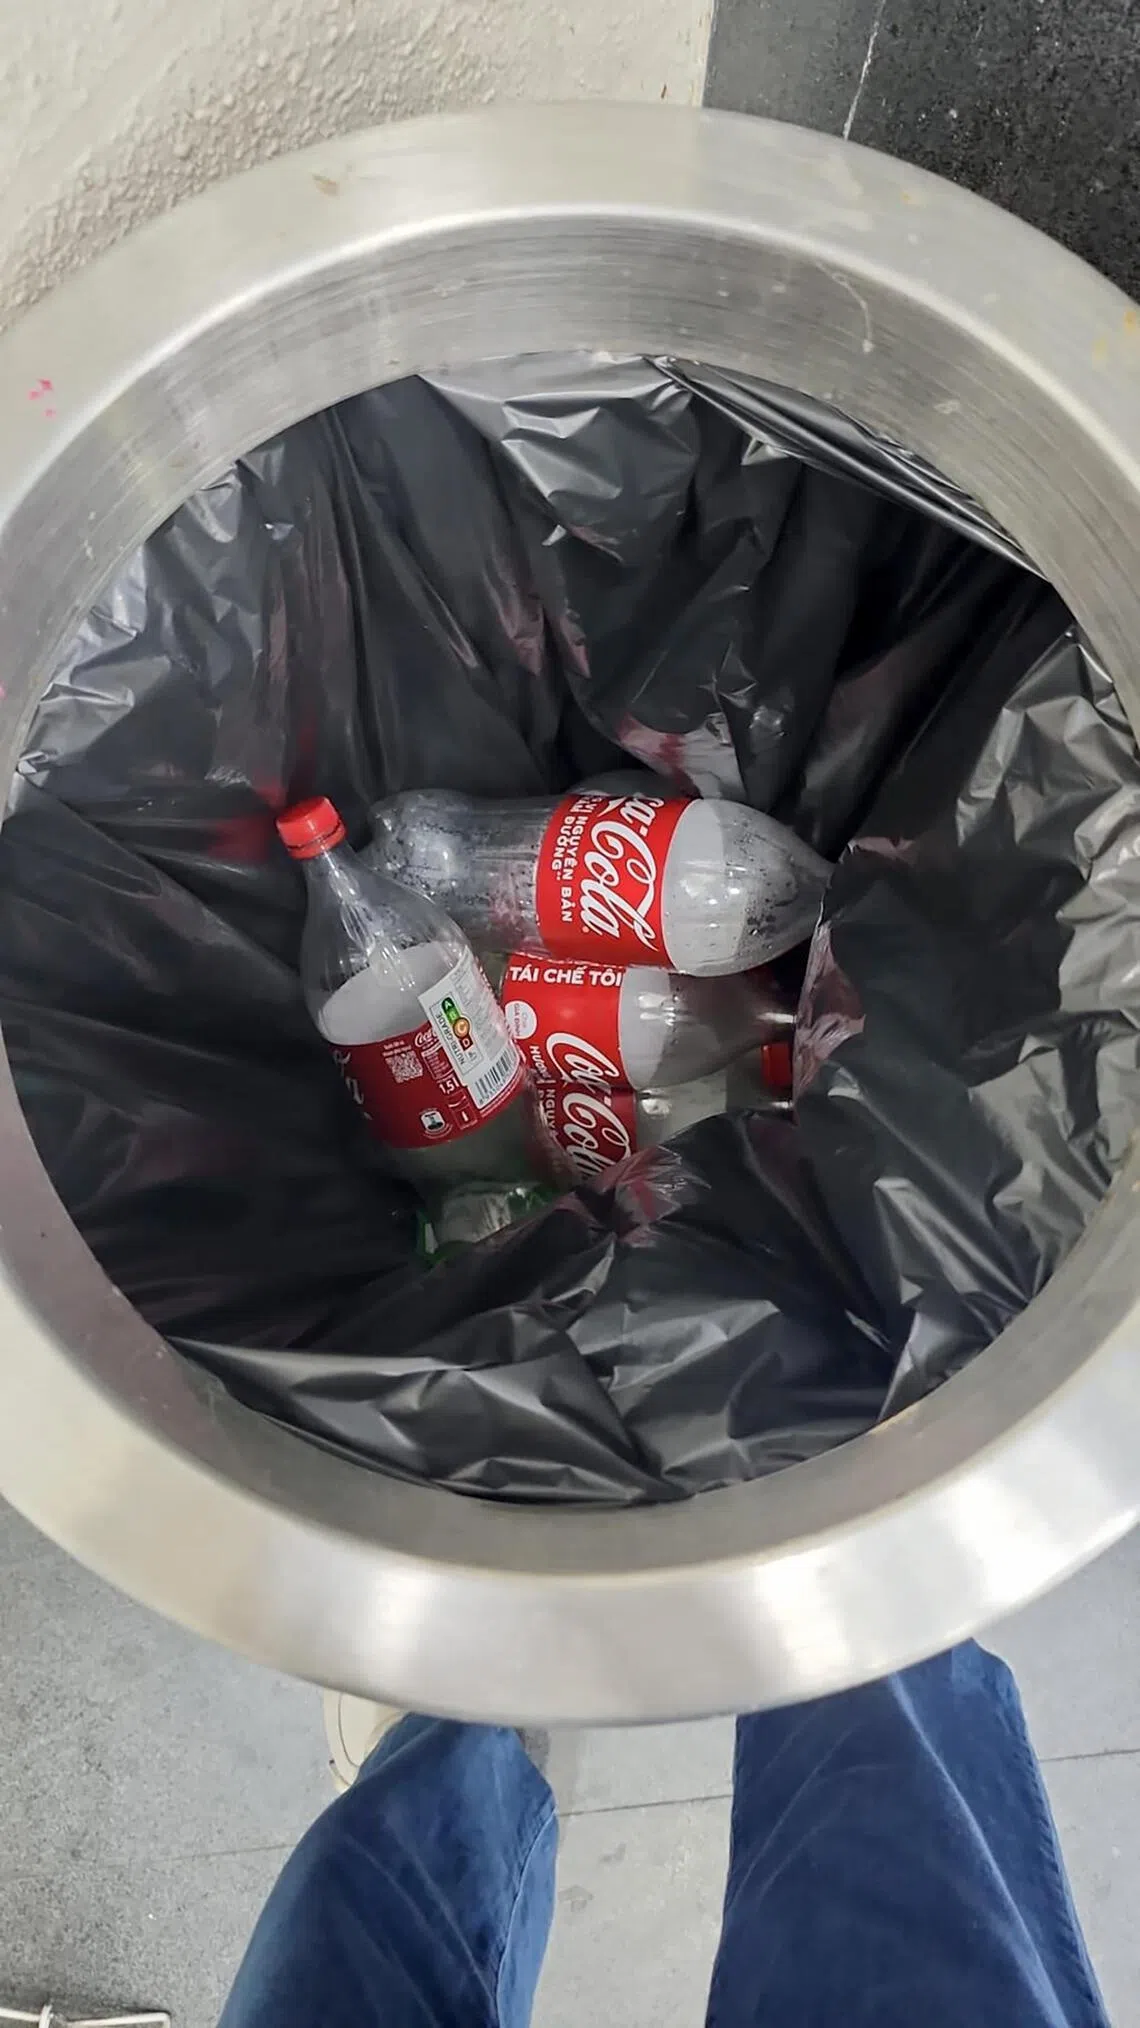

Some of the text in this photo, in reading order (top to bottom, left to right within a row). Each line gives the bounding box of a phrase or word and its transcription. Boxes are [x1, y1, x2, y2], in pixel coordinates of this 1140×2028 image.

[562, 815, 589, 880] NGUYÊN
[580, 796, 664, 952] ca-Cola
[561, 886, 576, 922] BẢN
[509, 964, 622, 987] TÁI CHẾ TÔI
[436, 1012, 465, 1065] NUTRI-GRADE
